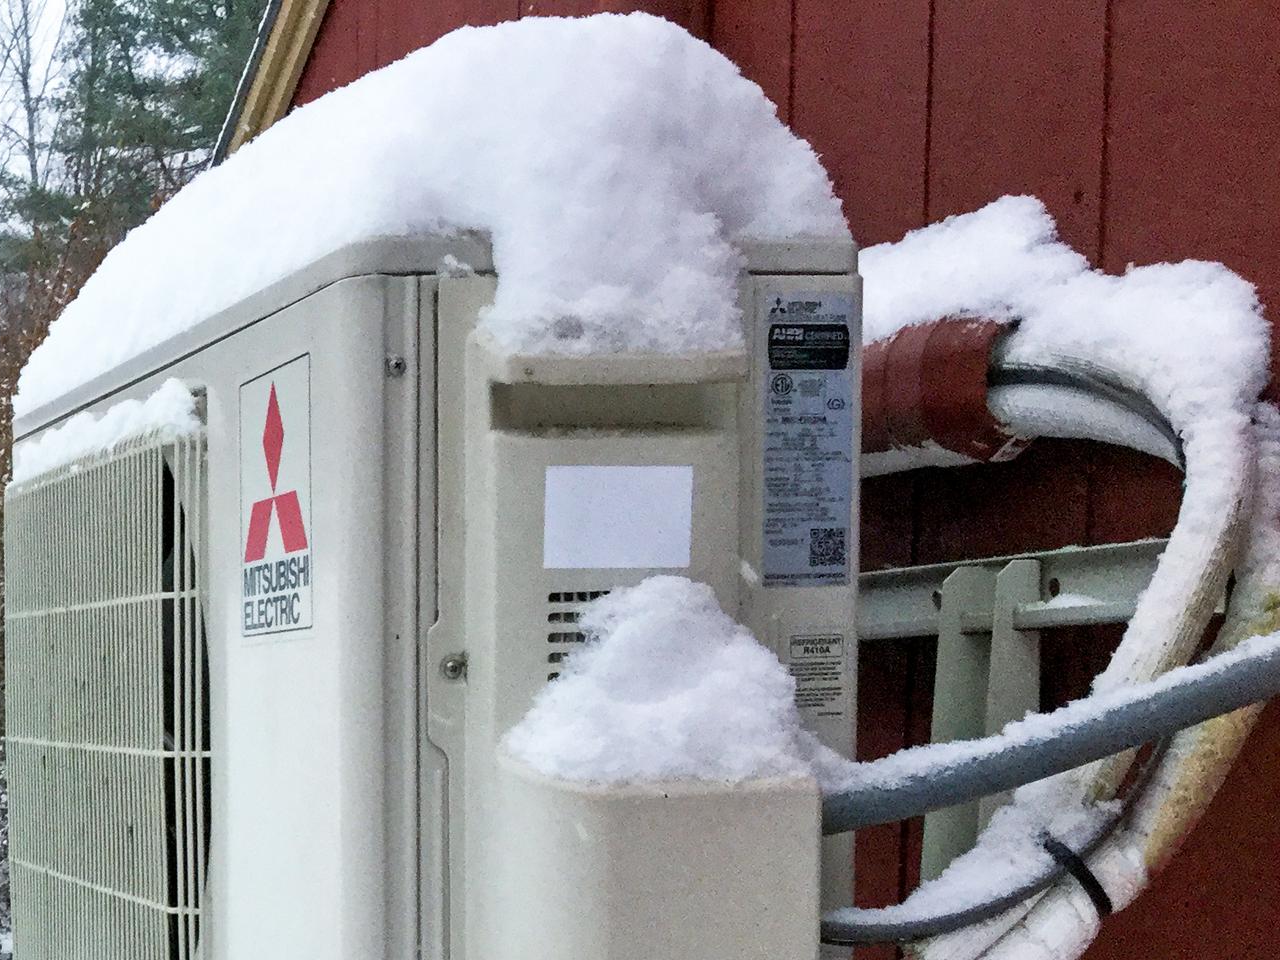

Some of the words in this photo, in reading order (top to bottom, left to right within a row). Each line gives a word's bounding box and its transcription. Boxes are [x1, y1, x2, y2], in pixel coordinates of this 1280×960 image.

[244, 554, 309, 598] MITSUBISHI
[244, 592, 300, 630] ELECTRIC
[803, 646, 831, 655] R410A
